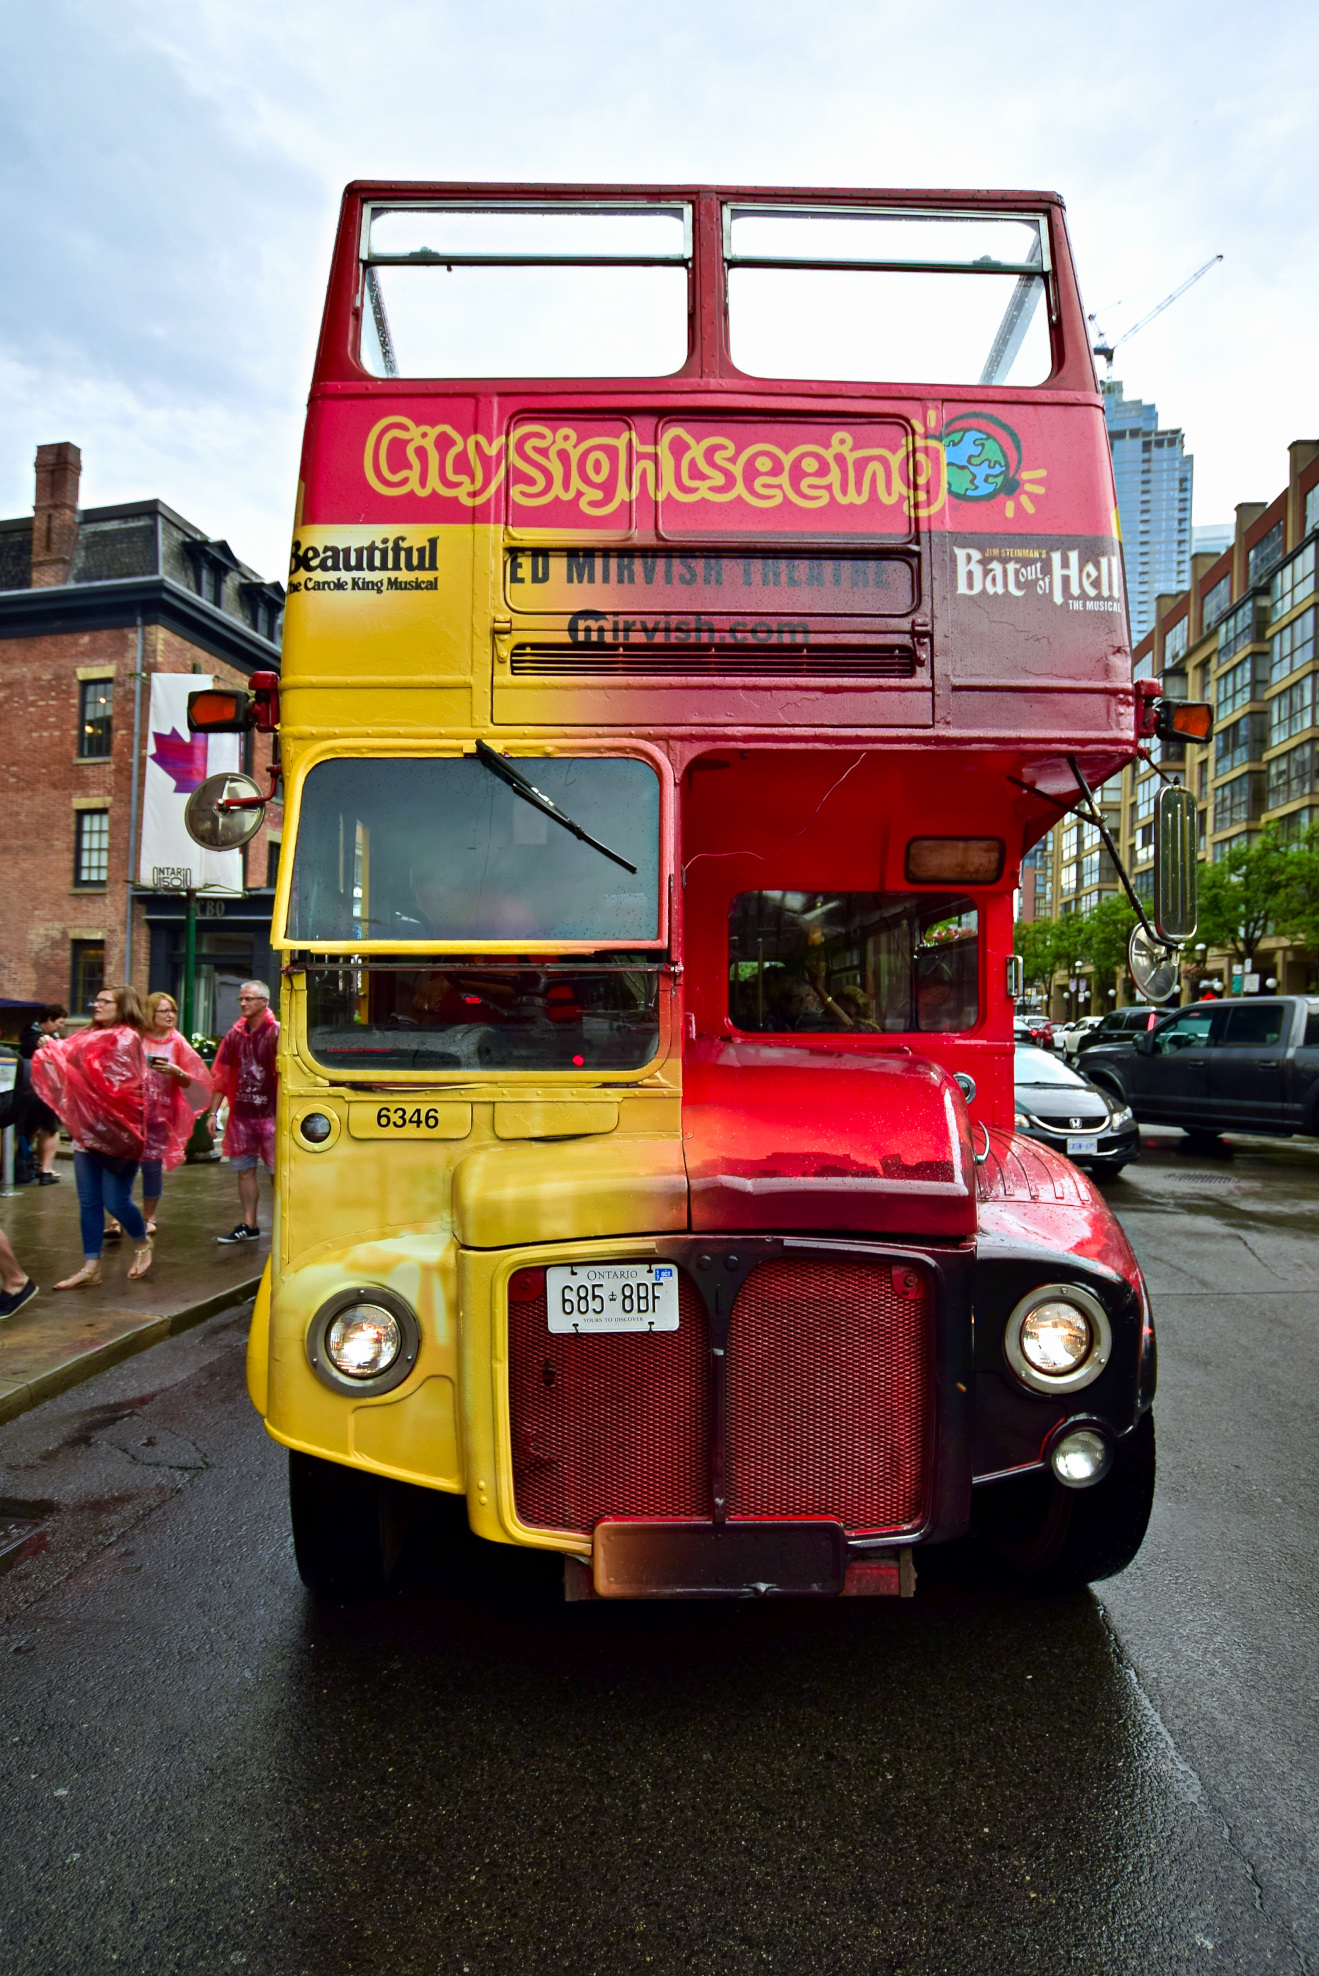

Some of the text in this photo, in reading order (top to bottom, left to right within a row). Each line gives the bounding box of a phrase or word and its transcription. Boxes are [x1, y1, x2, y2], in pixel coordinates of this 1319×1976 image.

[985, 548, 999, 558] JIM
[510, 551, 550, 584] ED
[566, 551, 723, 586] MIRVISH
[953, 545, 1121, 606] Bat out of Hell
[303, 577, 349, 592] Carole
[351, 577, 384, 594] King
[386, 576, 439, 591] Musical
[1068, 600, 1122, 613] THE MUSICAL
[195, 899, 226, 917] CBO
[376, 1106, 439, 1129] 6346
